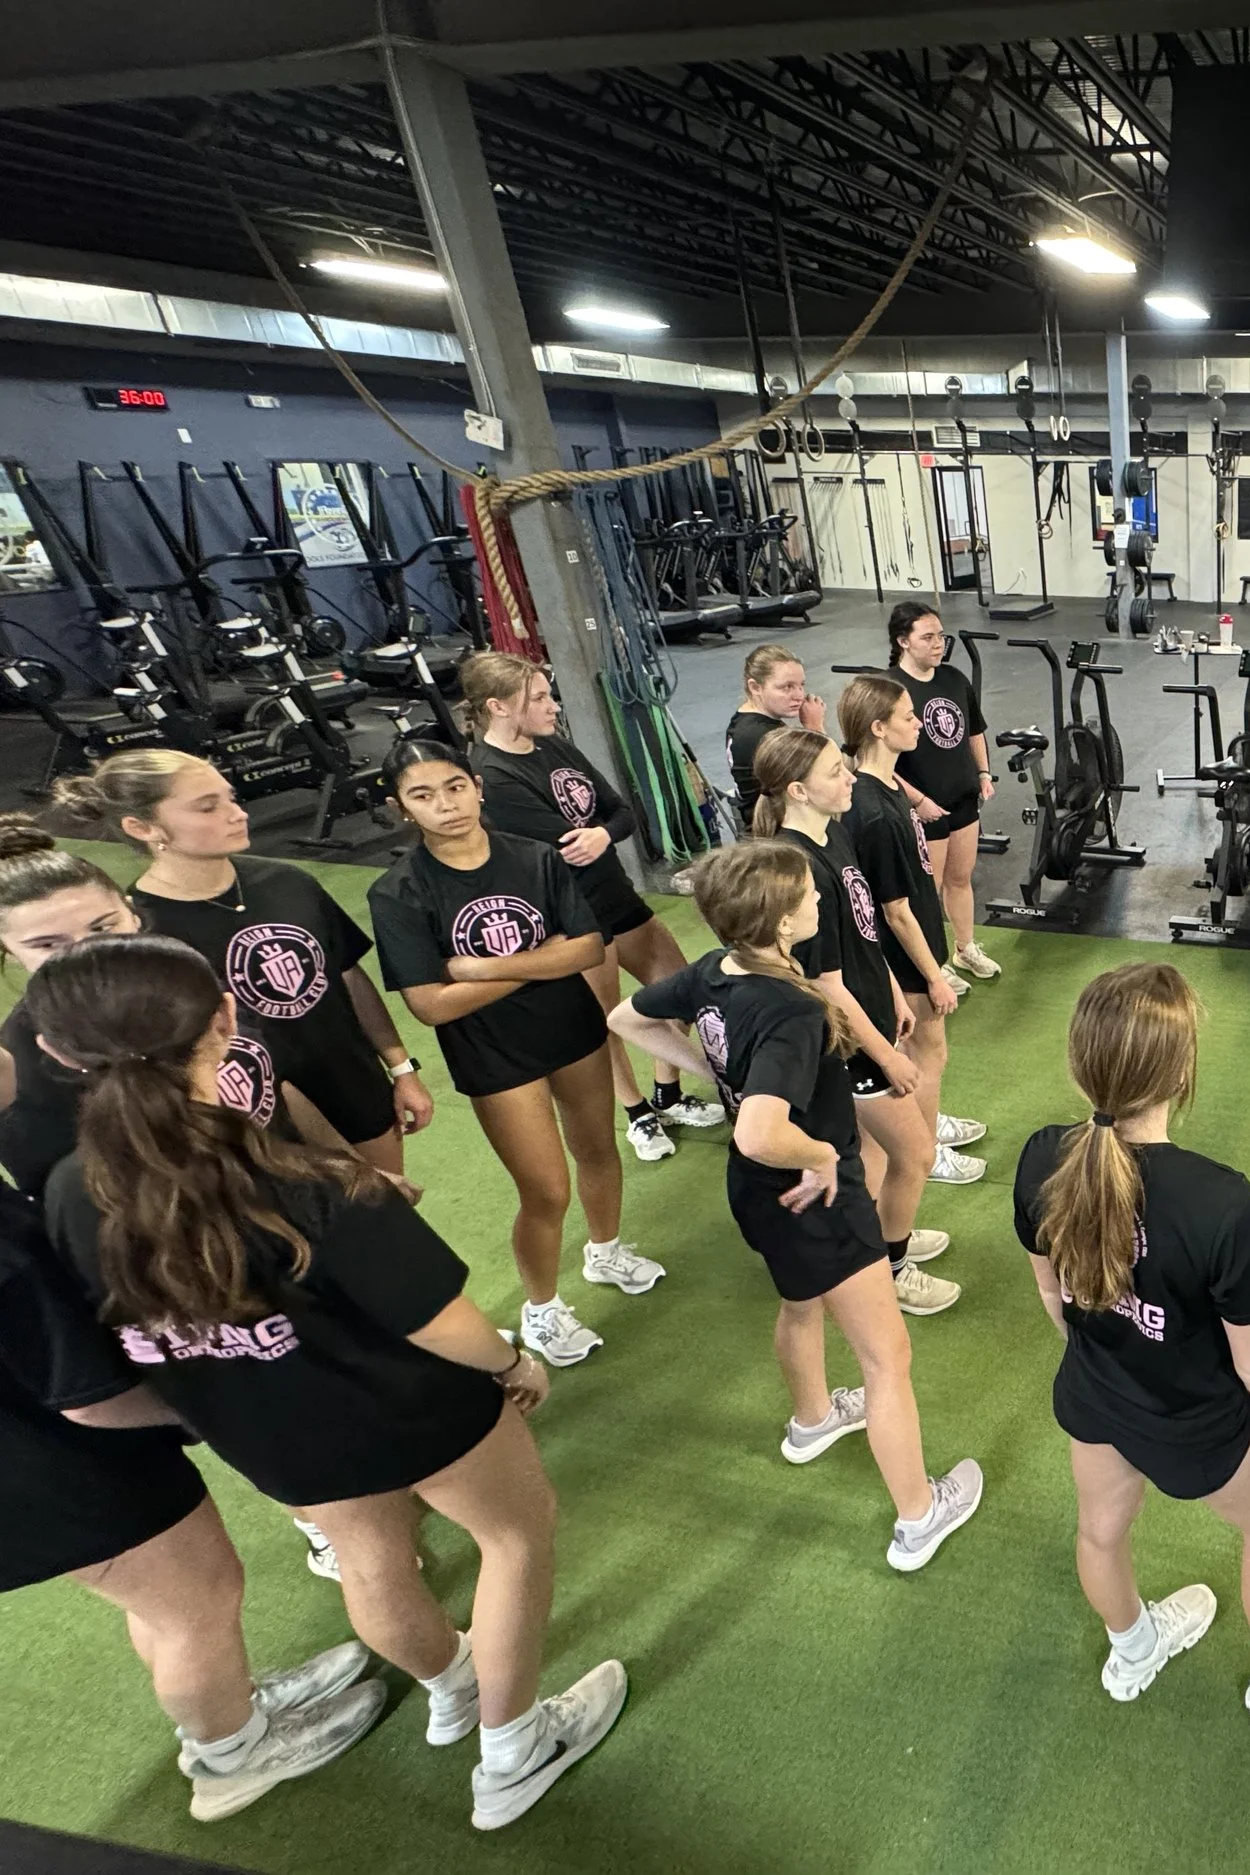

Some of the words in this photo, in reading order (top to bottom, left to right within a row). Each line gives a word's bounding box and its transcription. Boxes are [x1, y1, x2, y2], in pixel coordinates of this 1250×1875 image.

[119, 389, 165, 405] 36:00
[471, 899, 506, 914] REIGN
[1012, 907, 1047, 917] ROGUE
[236, 927, 273, 948] REIGN
[1199, 925, 1236, 935] ROGUE
